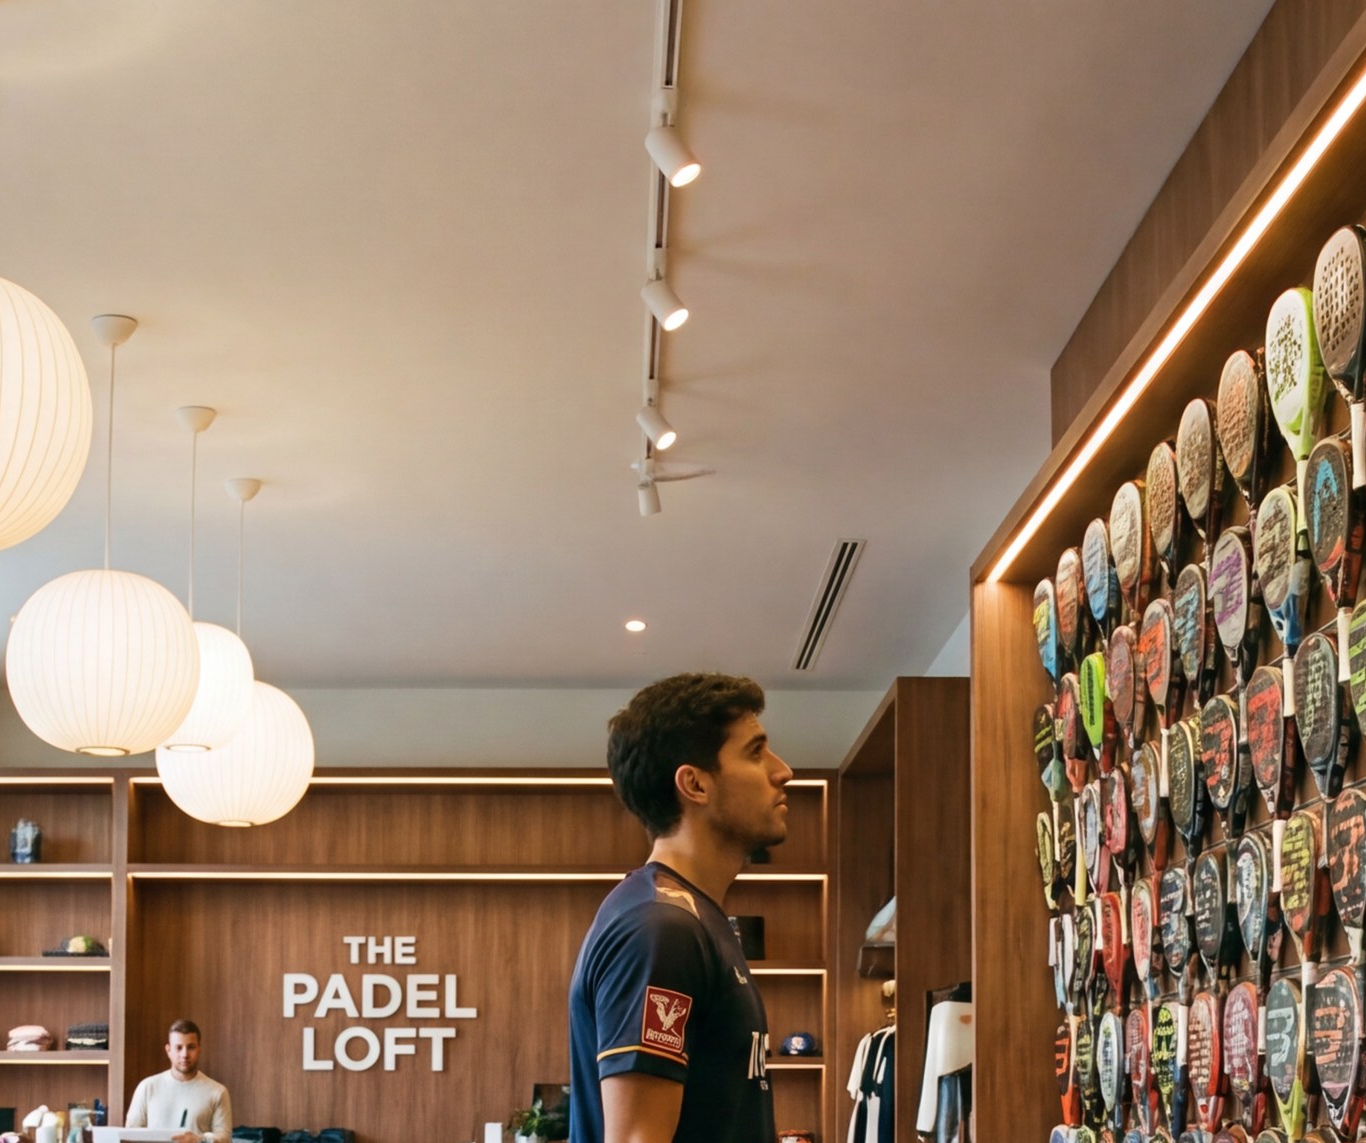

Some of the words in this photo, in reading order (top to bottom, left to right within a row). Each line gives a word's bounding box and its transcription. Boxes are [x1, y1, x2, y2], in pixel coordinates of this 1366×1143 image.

[343, 936, 417, 964] THE
[283, 973, 477, 1018] PADEL
[303, 1026, 456, 1071] LOFT
